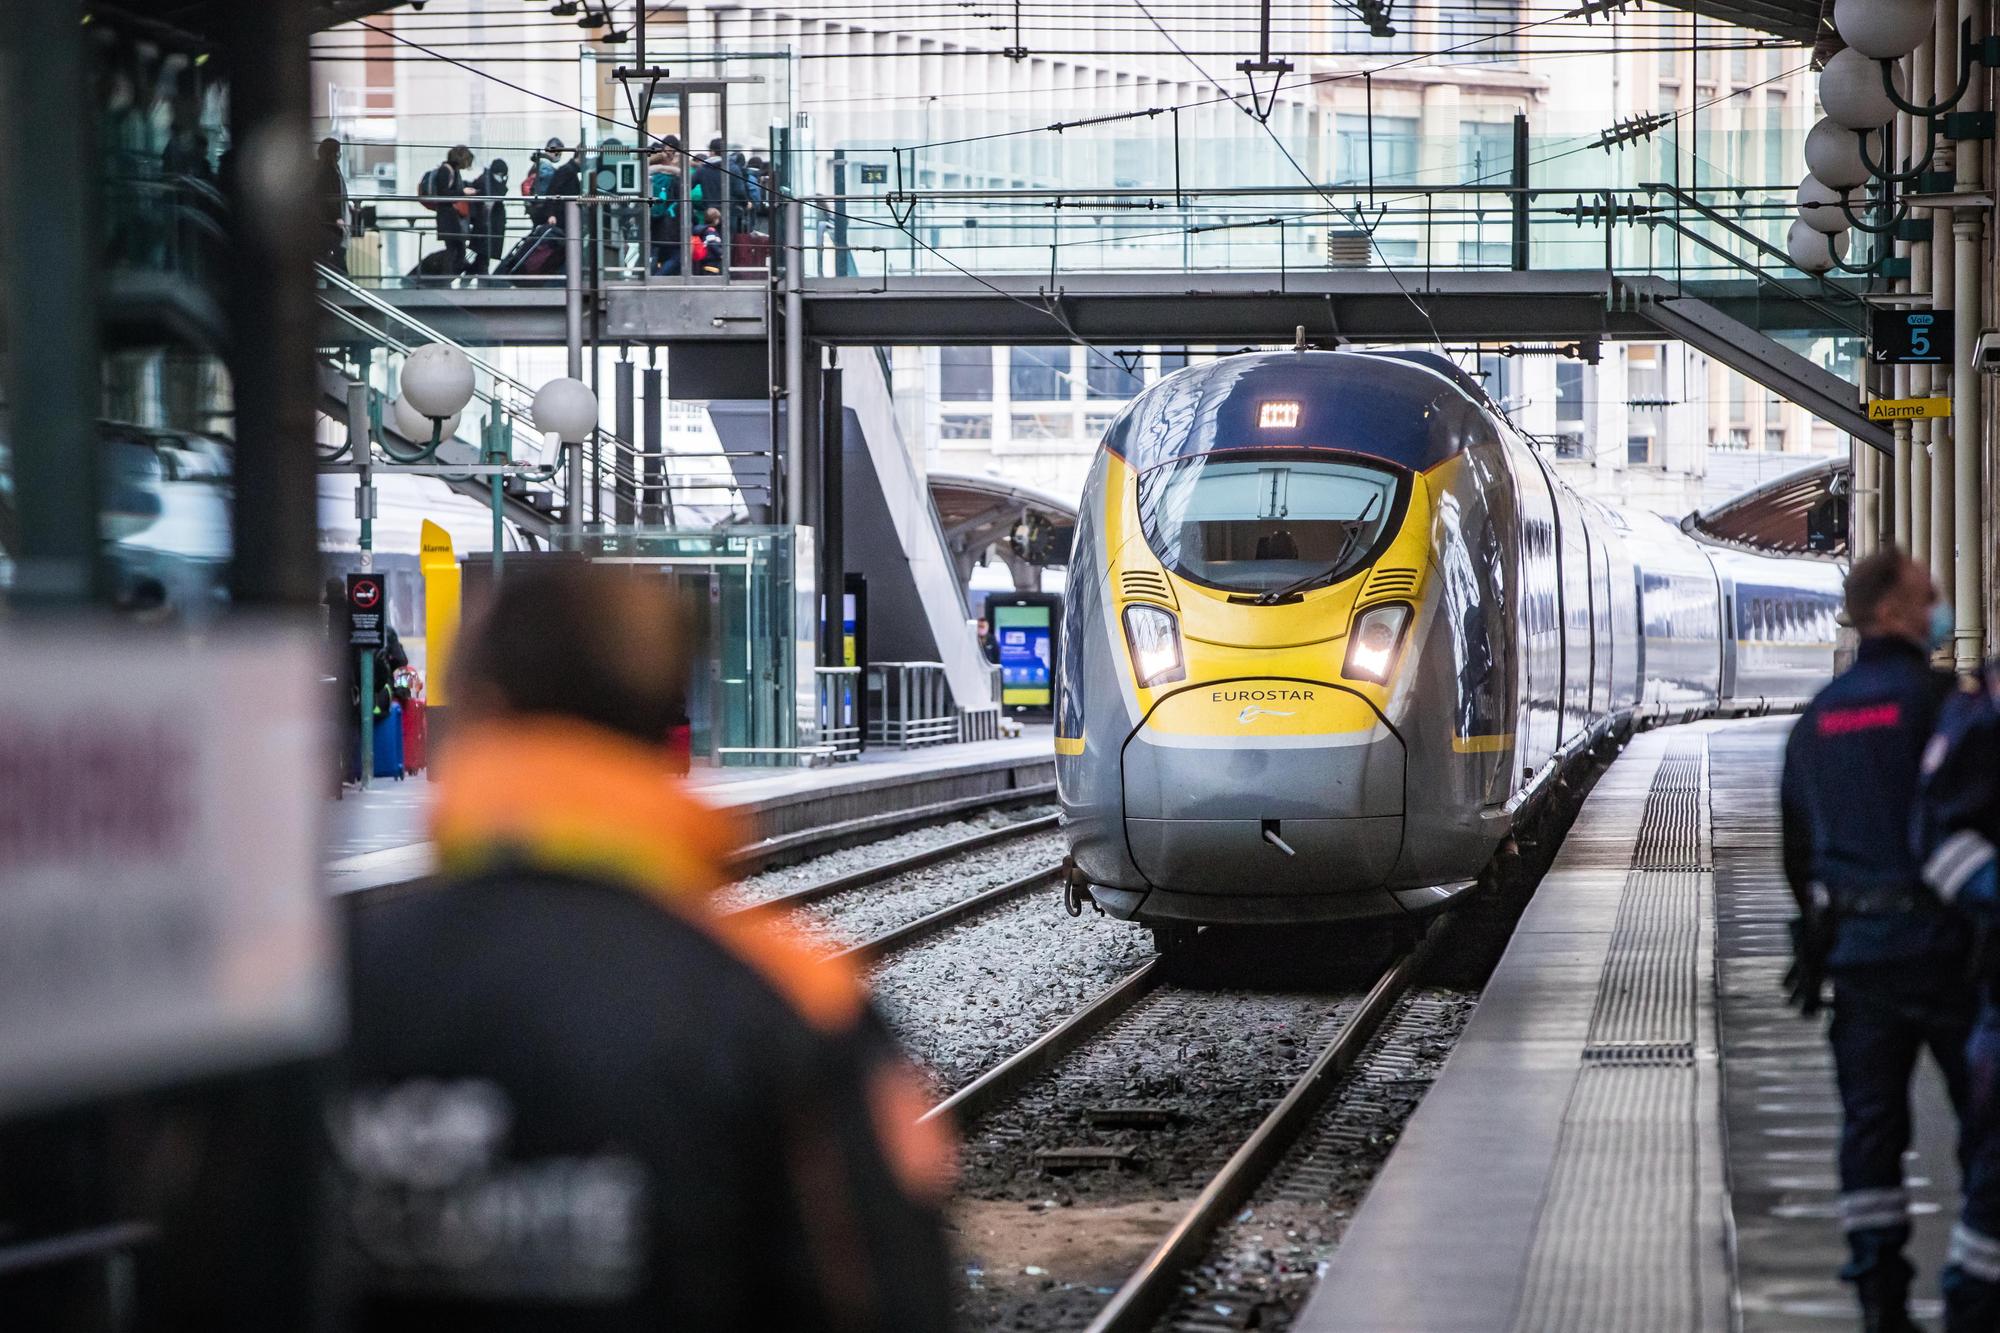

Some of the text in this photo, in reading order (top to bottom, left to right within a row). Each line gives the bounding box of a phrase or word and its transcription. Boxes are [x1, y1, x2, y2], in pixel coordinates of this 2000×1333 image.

[1911, 328, 1930, 355] 5
[1873, 405, 1925, 417] Alarme
[422, 544, 450, 552] Alarme
[1212, 690, 1314, 702] EUROSTAR
